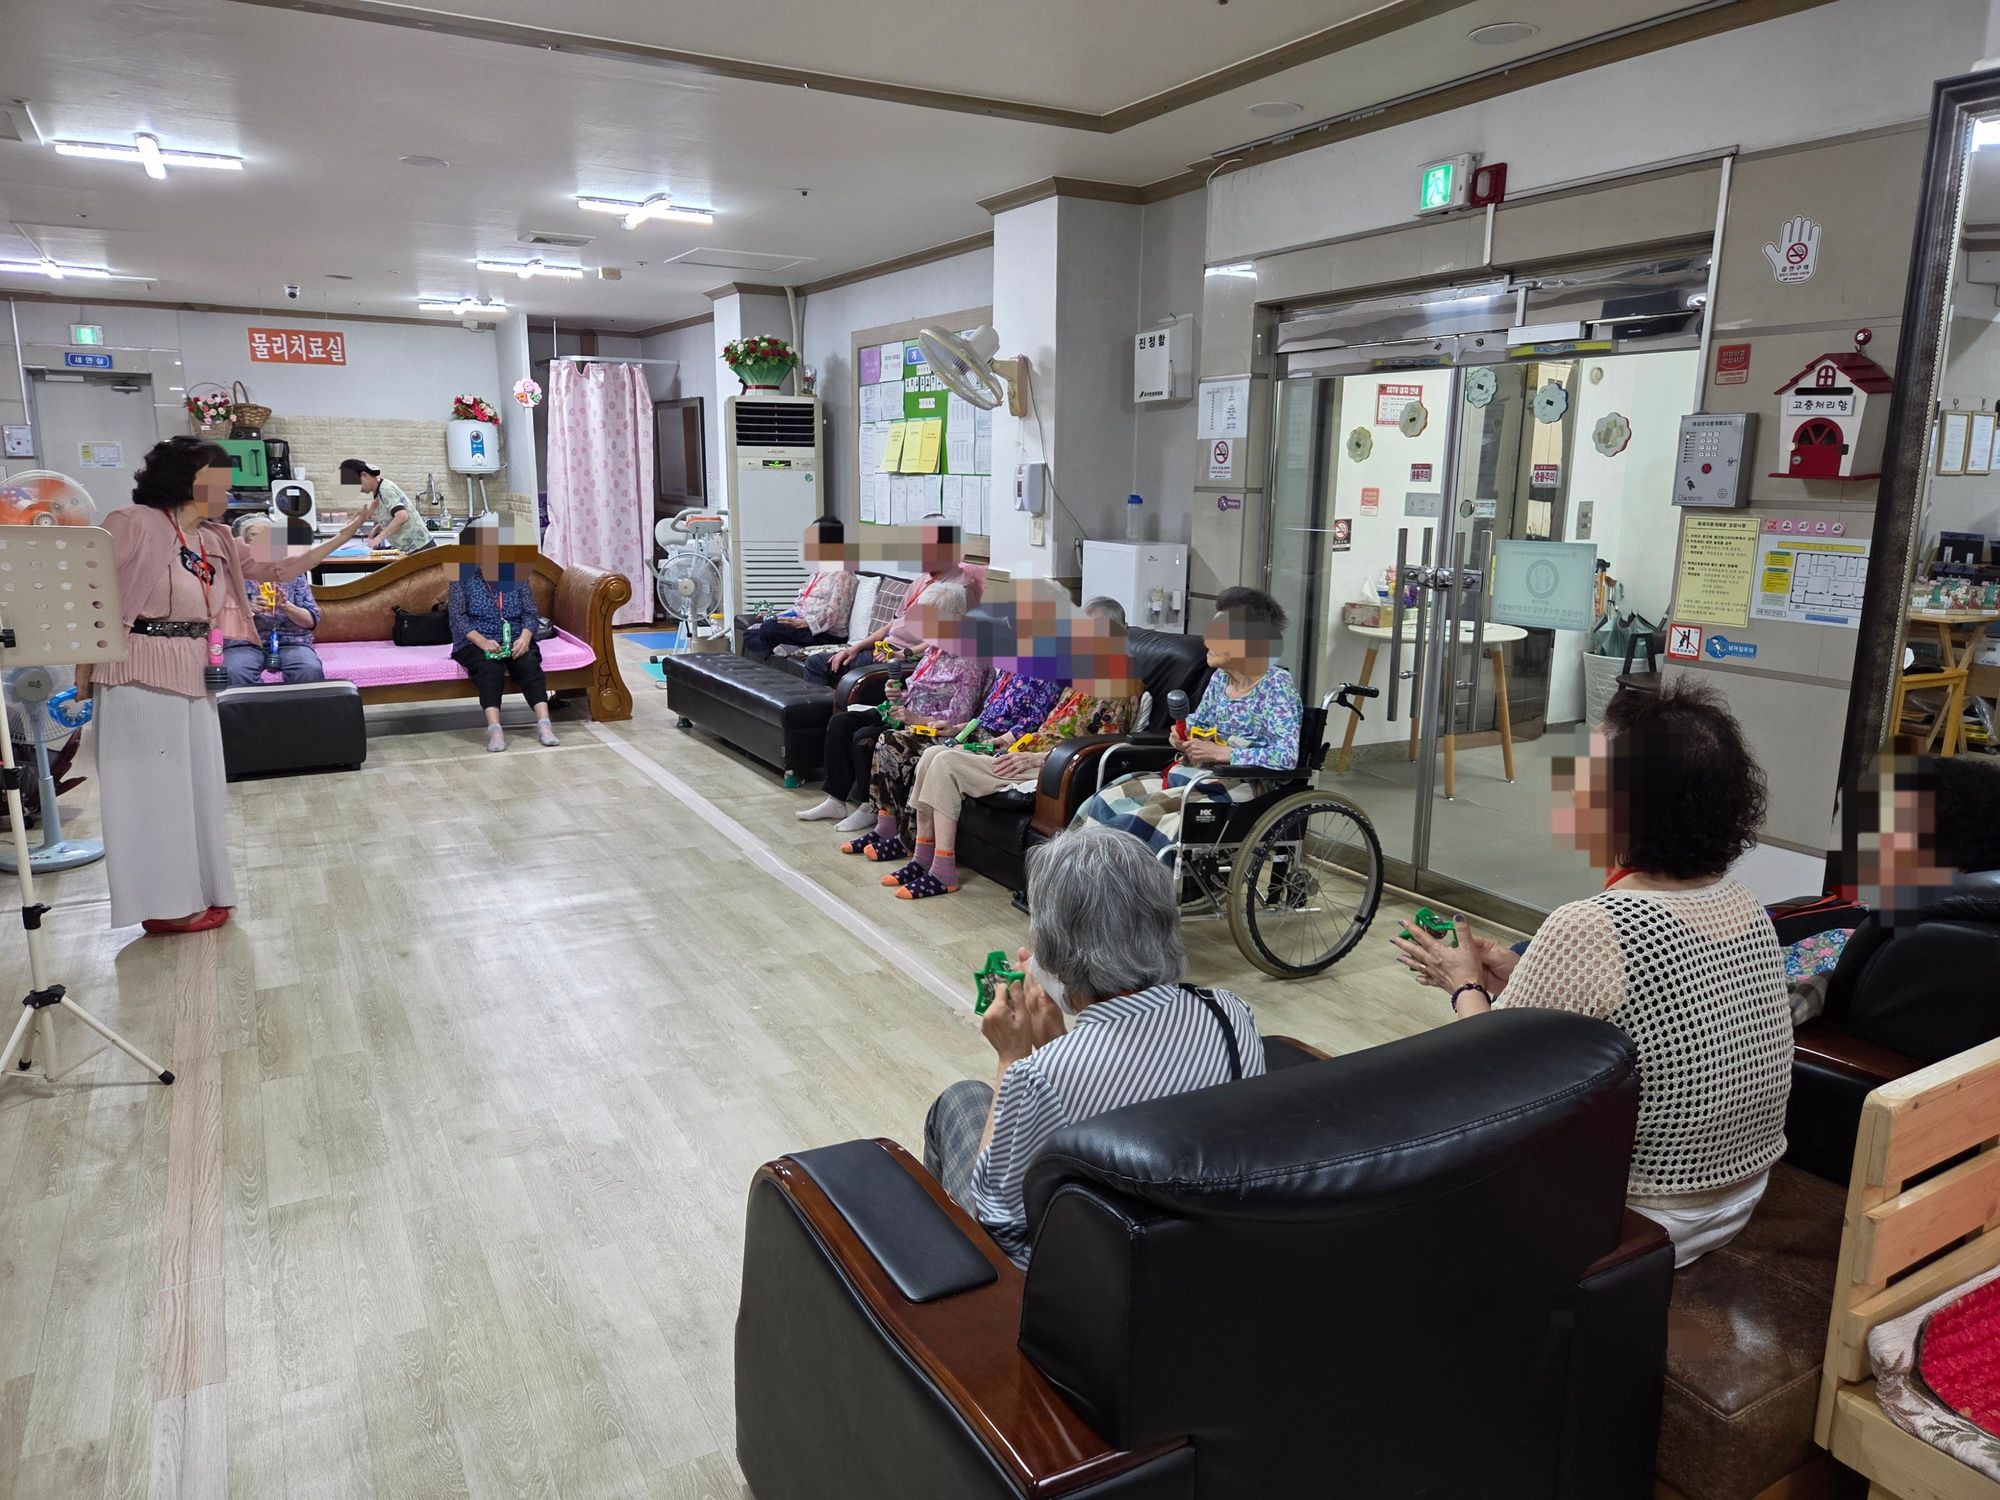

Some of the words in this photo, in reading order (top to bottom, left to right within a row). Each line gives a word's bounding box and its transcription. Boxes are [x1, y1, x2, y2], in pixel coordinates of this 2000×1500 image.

[1781, 264, 1809, 273] 금연구역
[1139, 334, 1165, 349] 진정함
[251, 332, 344, 363] 물리치료실
[74, 356, 104, 365] 세면실
[1793, 400, 1848, 411] 고충처리함
[1534, 471, 1555, 483] 충돌주의
[1728, 644, 1755, 653] 넘어짐주의
